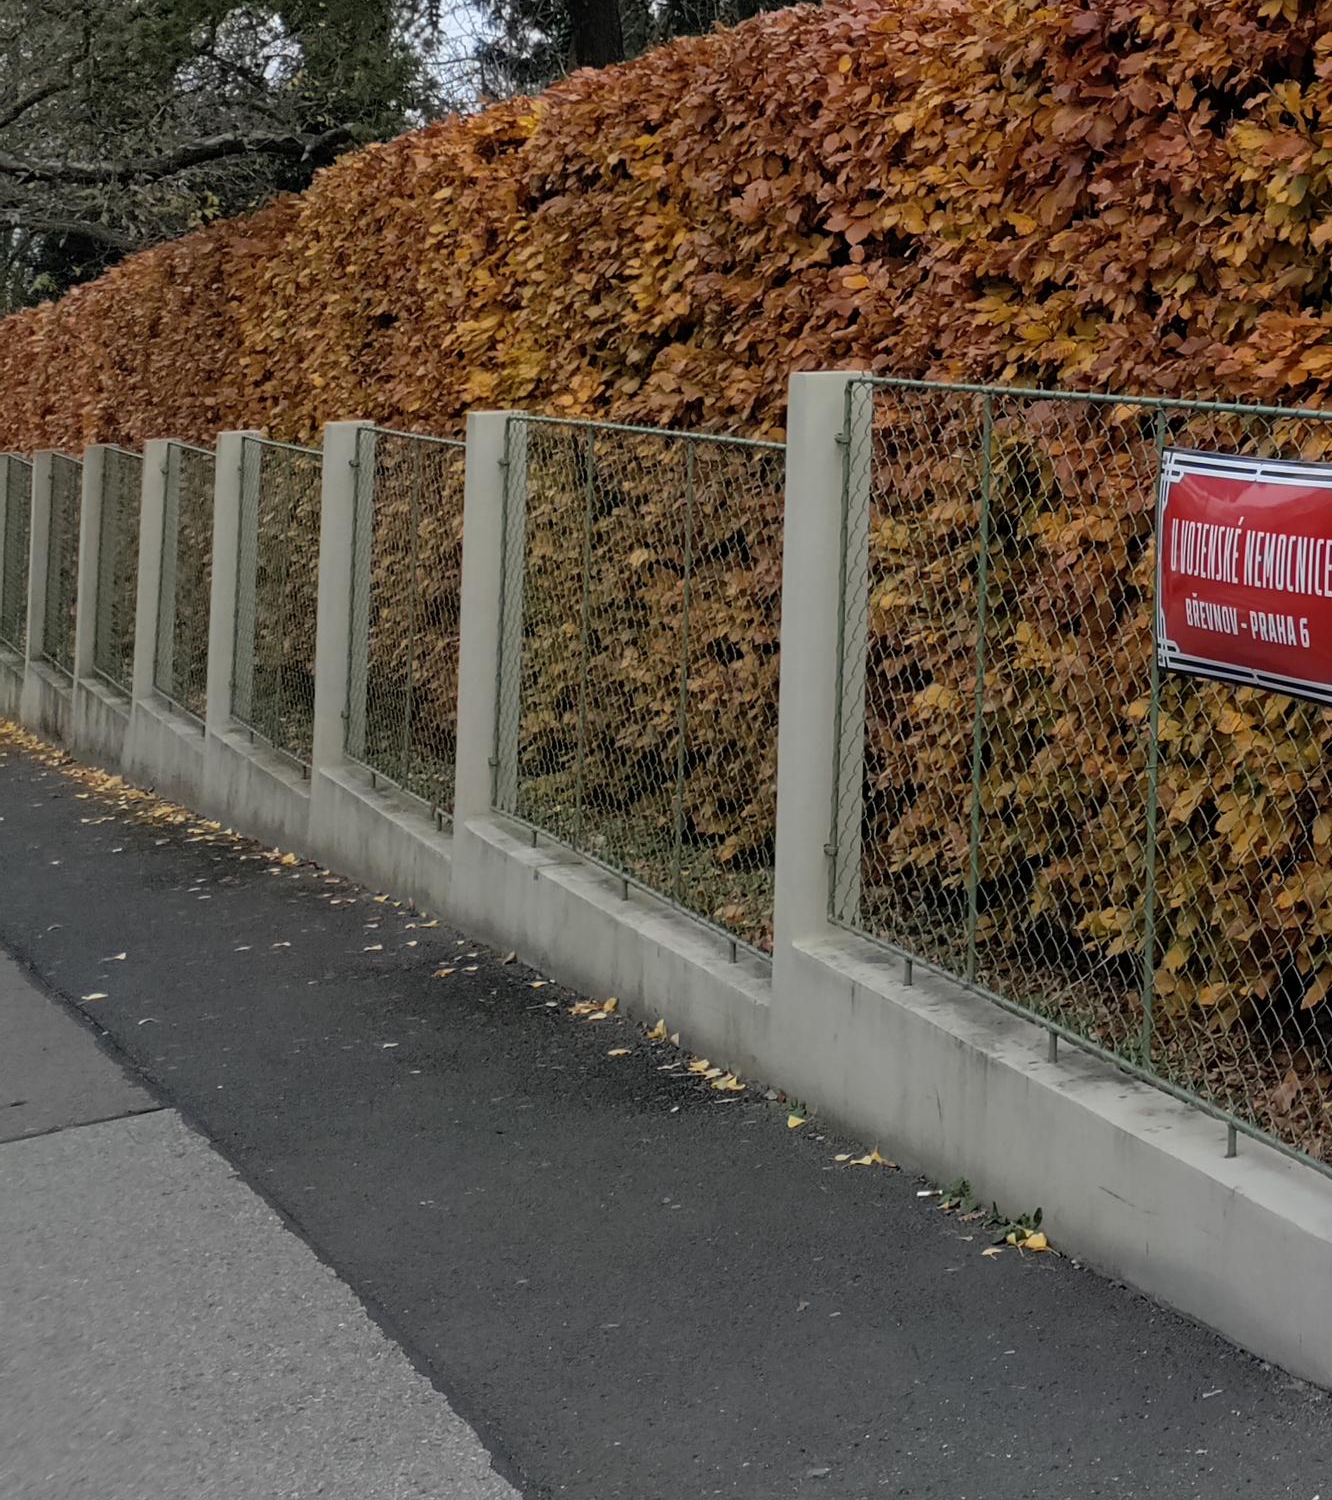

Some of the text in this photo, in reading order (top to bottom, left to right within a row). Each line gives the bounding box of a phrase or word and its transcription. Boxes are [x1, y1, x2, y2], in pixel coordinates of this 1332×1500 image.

[1170, 518, 1178, 572] U
[1180, 517, 1243, 584] VOJENSKÉ
[1185, 592, 1239, 636] BŘEVNOV
[1250, 610, 1297, 646] PRAHA
[1299, 618, 1310, 648] 6
